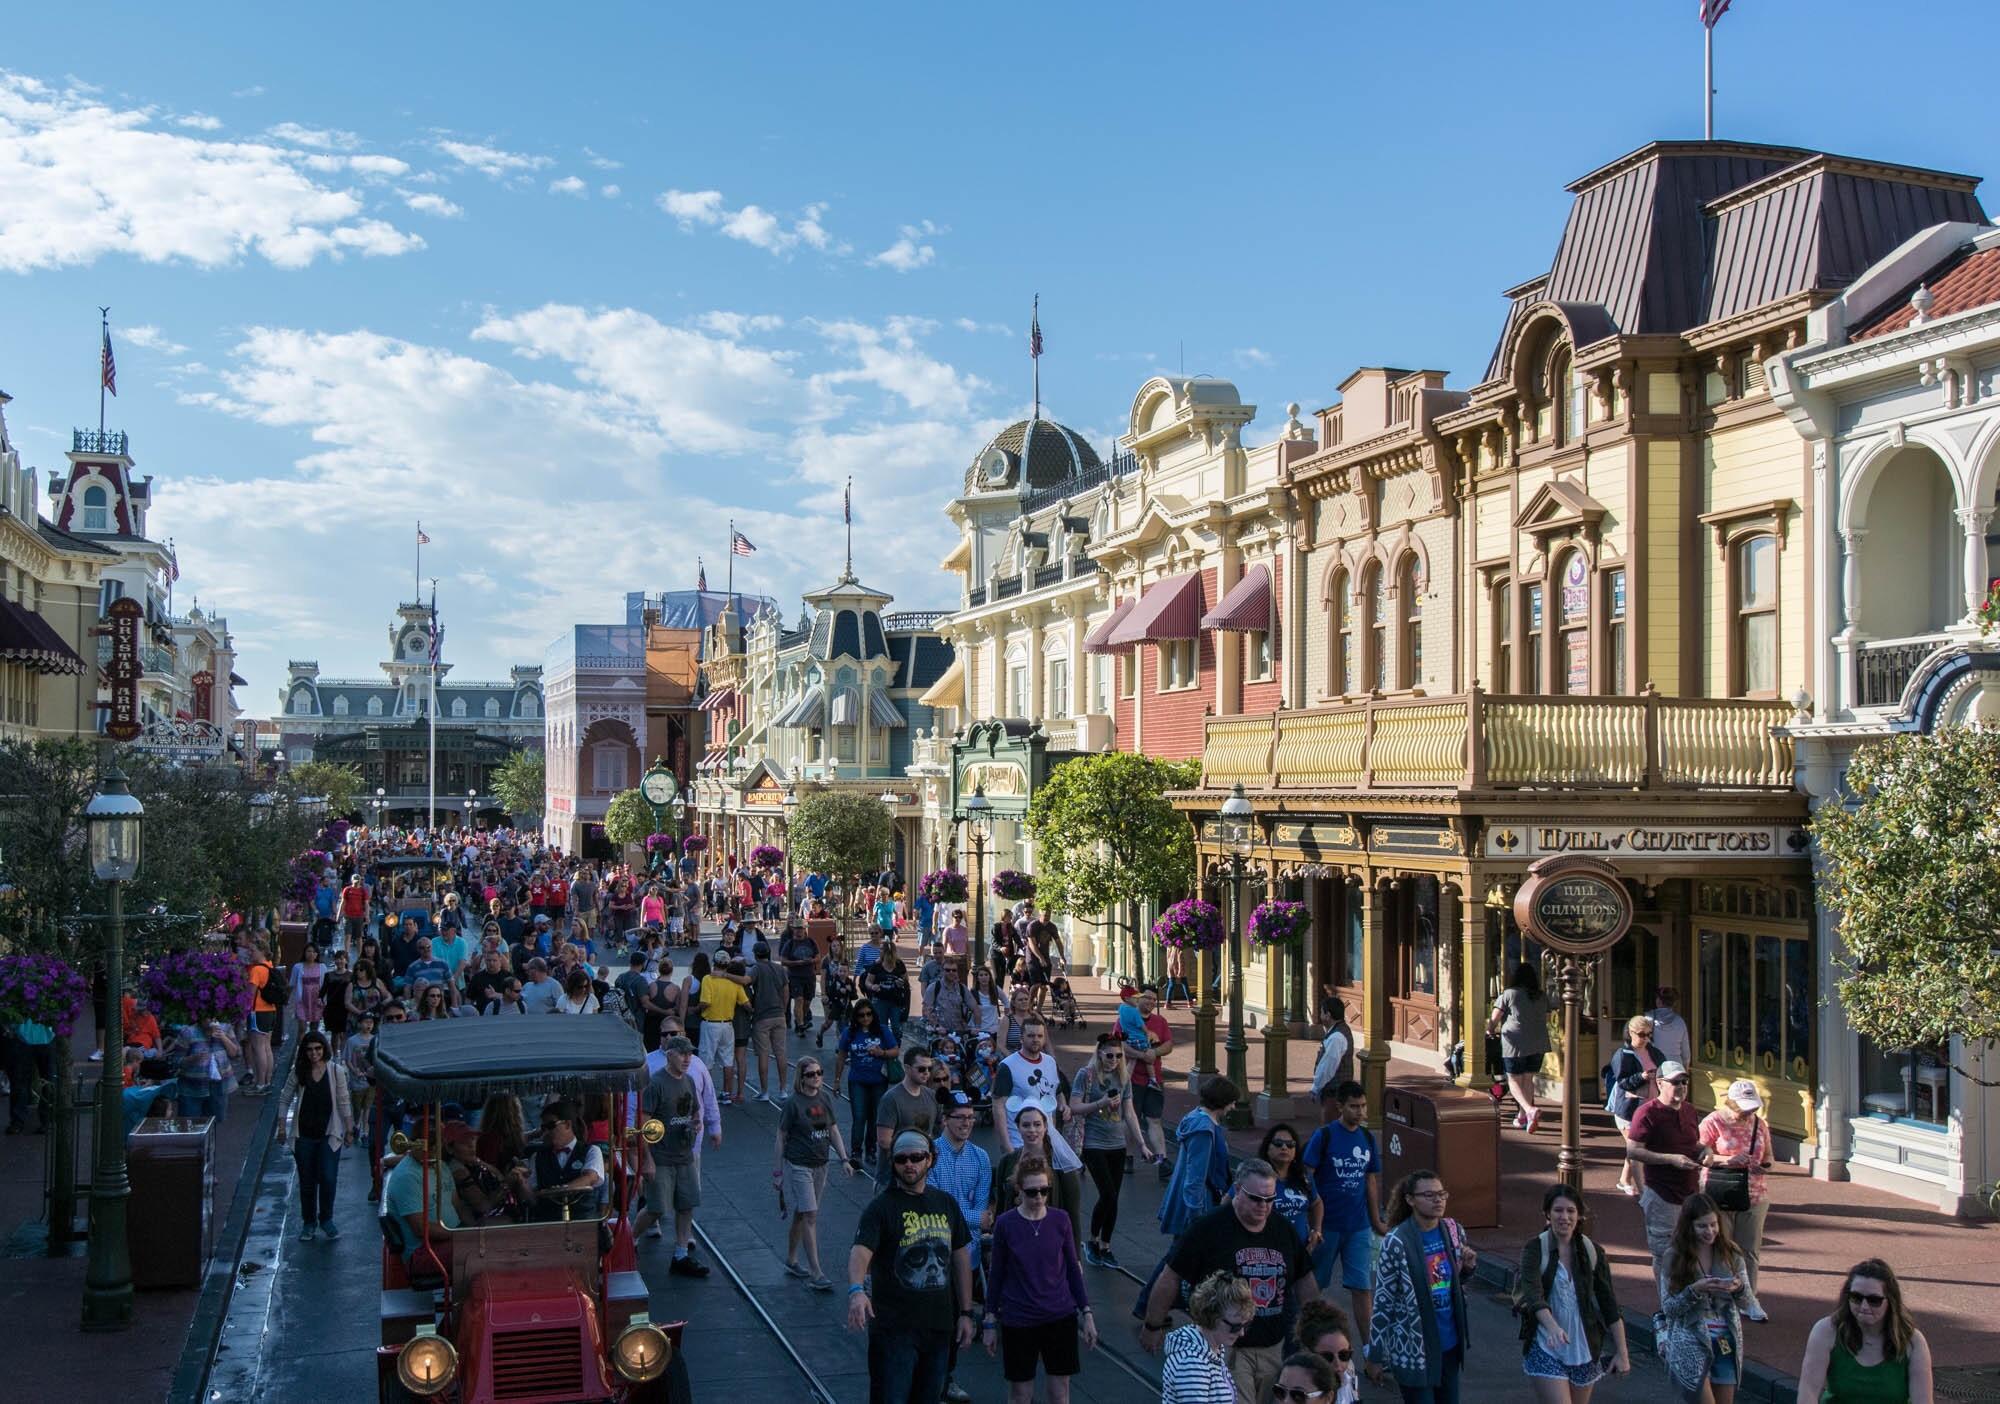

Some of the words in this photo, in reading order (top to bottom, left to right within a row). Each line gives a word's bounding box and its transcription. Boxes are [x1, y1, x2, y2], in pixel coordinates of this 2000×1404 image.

[119, 618, 132, 678] CRYSTAL
[117, 687, 130, 721] ARTS
[747, 792, 785, 801] EMPORIUM
[1538, 828, 1609, 851] HALL
[1611, 834, 1625, 849] of
[1626, 828, 1770, 851] CHAMPIONS
[1564, 886, 1598, 896] HALL
[1541, 904, 1617, 915] CHAMPIONS
[902, 1211, 949, 1236] Bone
